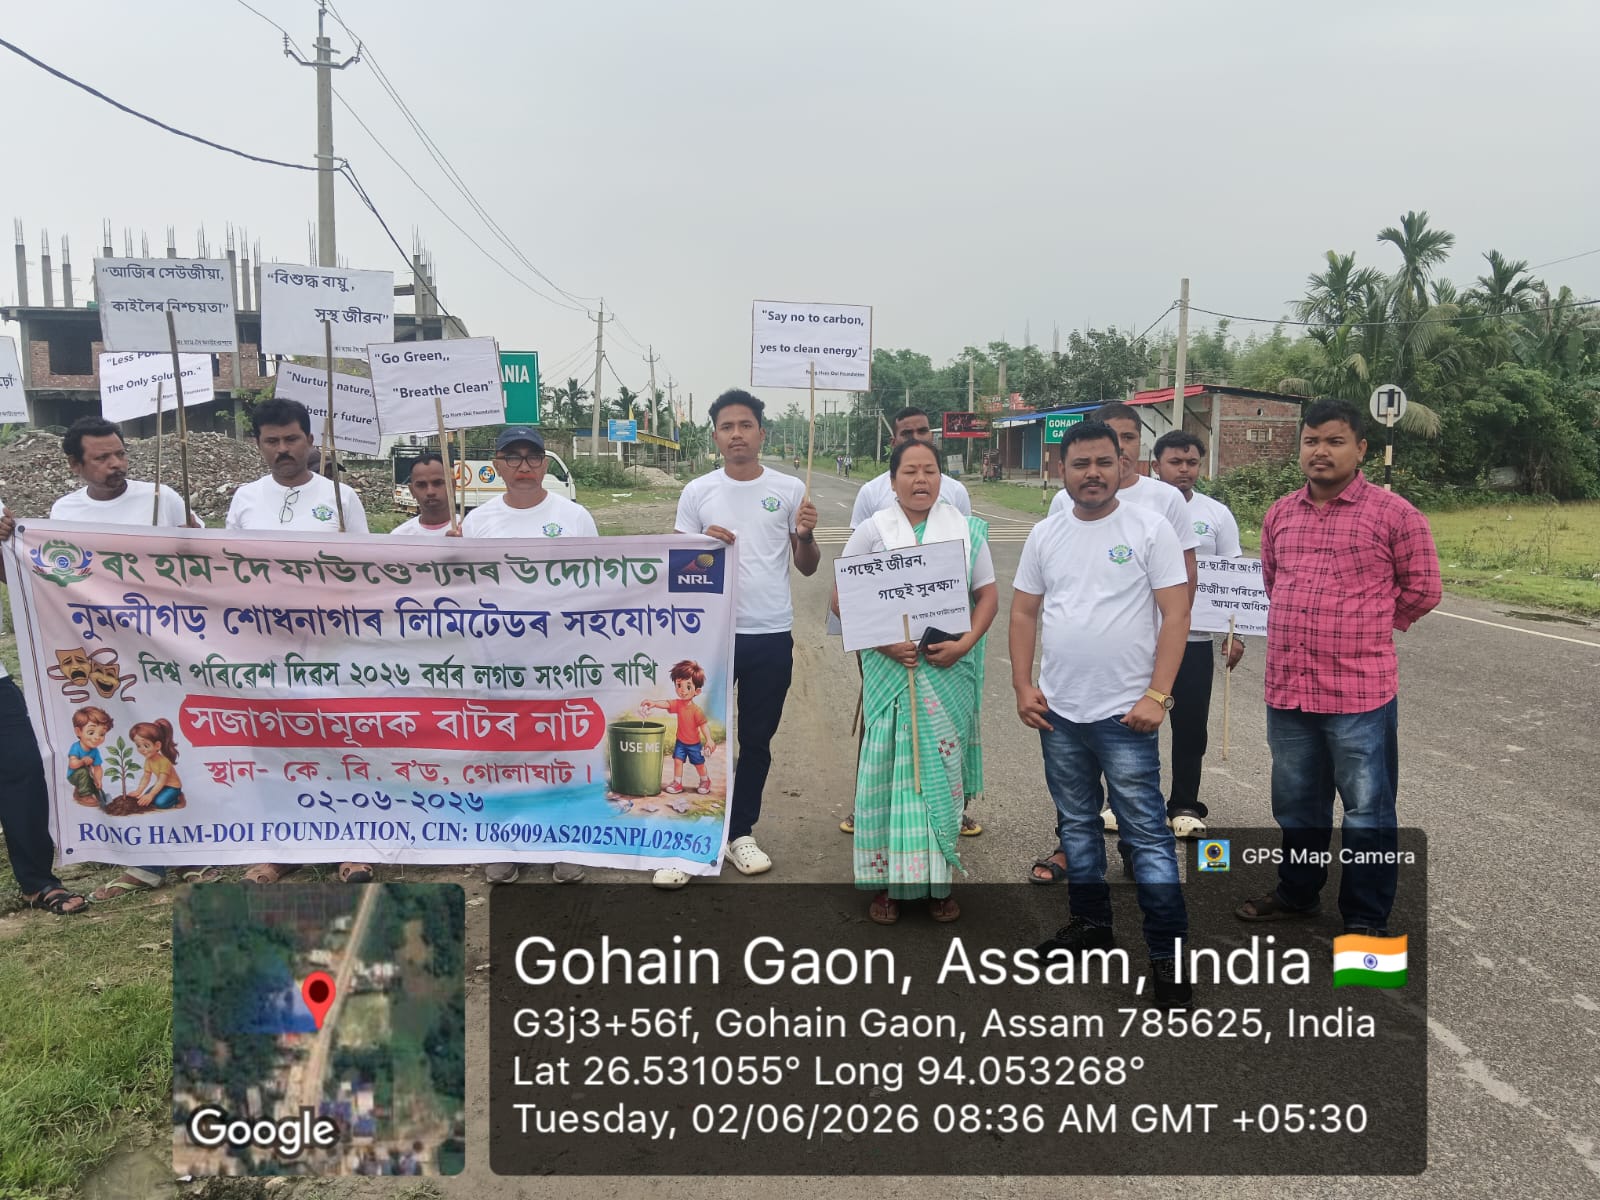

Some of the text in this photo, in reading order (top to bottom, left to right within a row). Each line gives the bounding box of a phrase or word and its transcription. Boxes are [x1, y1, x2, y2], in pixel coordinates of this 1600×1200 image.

[762, 310, 864, 326] "Say no to carbon,
[106, 353, 134, 367] "Less
[374, 353, 400, 364] "Go
[760, 344, 863, 358] yes to clean energy"
[106, 367, 202, 394] The Only Soluon."
[287, 371, 334, 388] "Nurtur
[393, 380, 493, 399] "Breathe Clean"
[306, 405, 377, 425] bettr future"
[96, 551, 145, 583] ৰং
[147, 548, 271, 586] হাম-দৈ
[504, 553, 663, 588] উদ্যোগত
[677, 574, 714, 586] NRL
[878, 583, 914, 600] গছেই
[67, 592, 706, 640] নুমলীগড় শোধনাগাৰ লিমিটেডৰ সহযোগত
[138, 651, 182, 687] বিশ্ব
[188, 652, 276, 689] পৰিৱেশ
[283, 652, 341, 689] দিৱস
[350, 661, 410, 688] ২০২৬
[472, 662, 527, 690] লগত
[535, 653, 605, 690] সংগতি
[612, 652, 659, 687] ৰাখি
[185, 699, 595, 747] সজাগতামূলক বাটৰ নাট
[619, 740, 661, 753] USE ME
[463, 758, 576, 785] গোলাঘাট
[297, 789, 485, 813] ০২-০৬-২০২৬
[78, 820, 712, 855] RONG HAM-DOI FOUNDATION, CIN: U86909AS2025NPL028563
